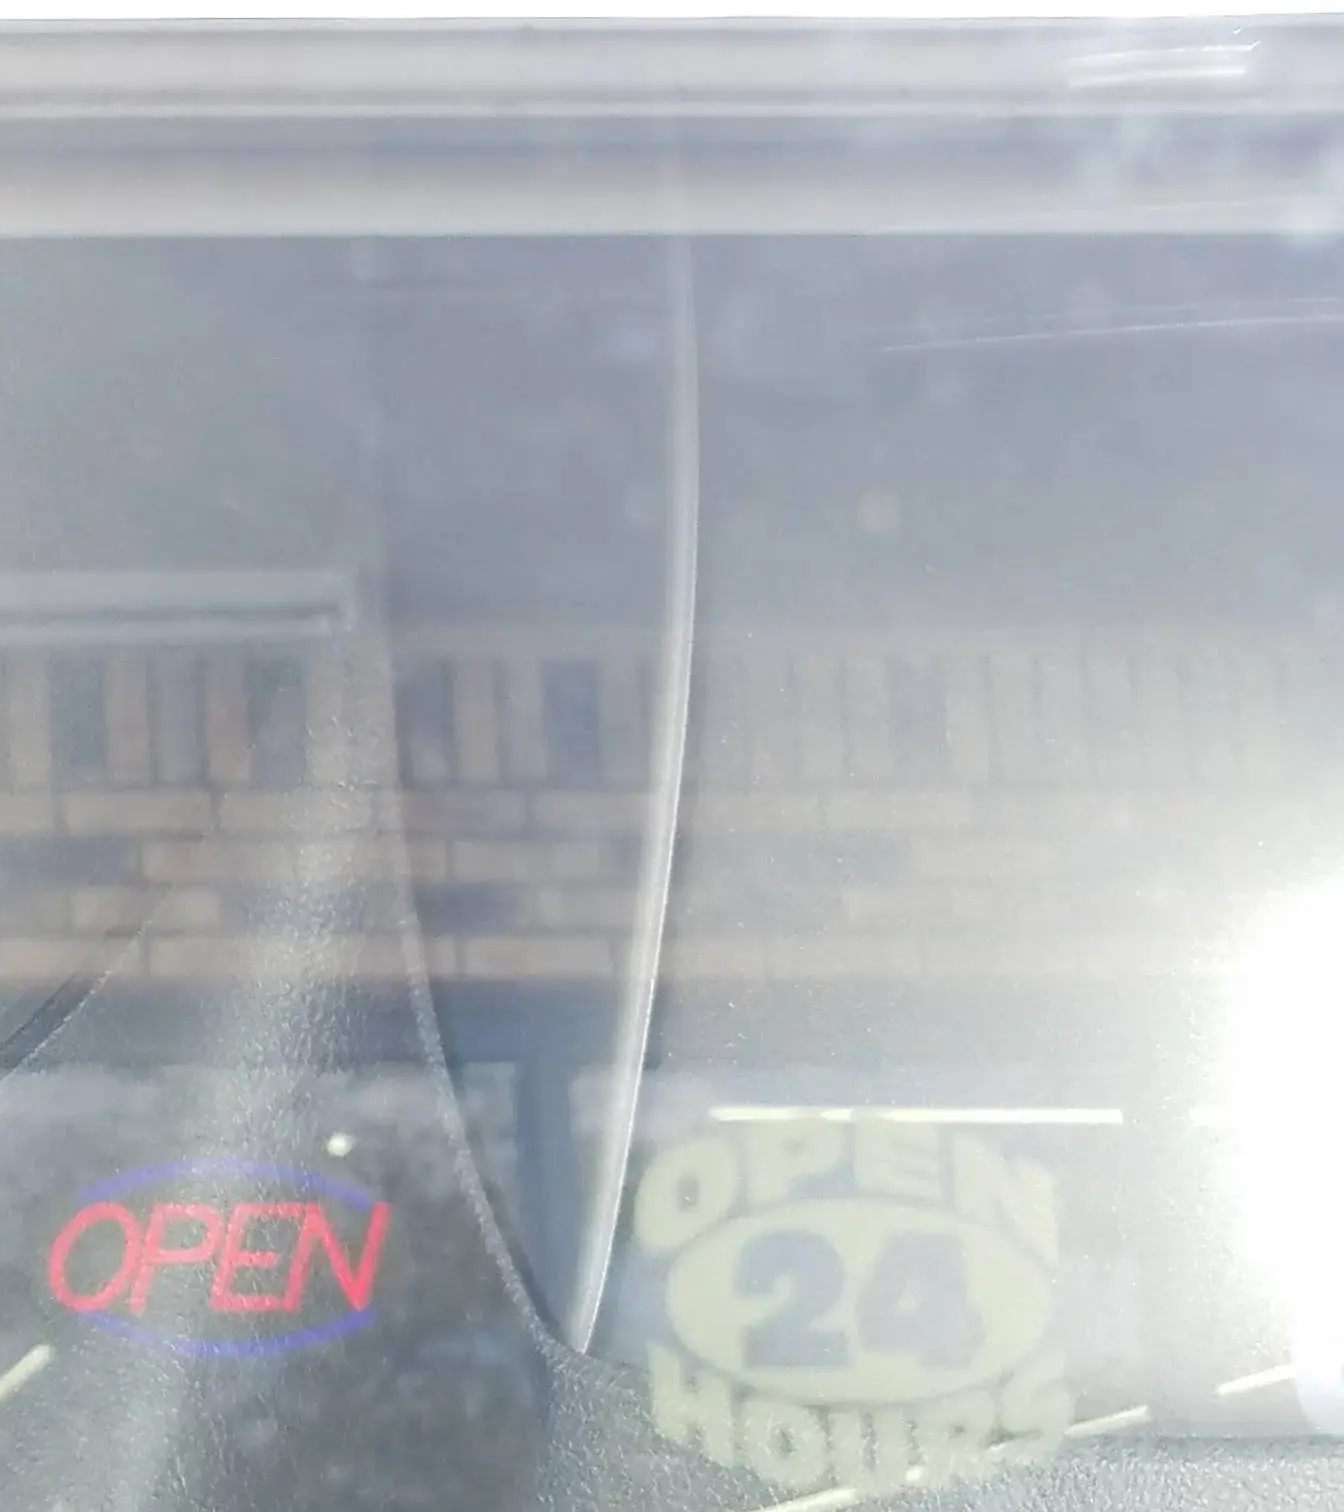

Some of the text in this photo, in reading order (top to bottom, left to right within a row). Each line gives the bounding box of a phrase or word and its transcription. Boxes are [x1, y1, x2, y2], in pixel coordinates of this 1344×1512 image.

[49, 1201, 390, 1315] OPEN
[635, 1118, 1058, 1266] OPEN
[732, 1229, 986, 1368] 24
[646, 1340, 1074, 1498] HOURS
